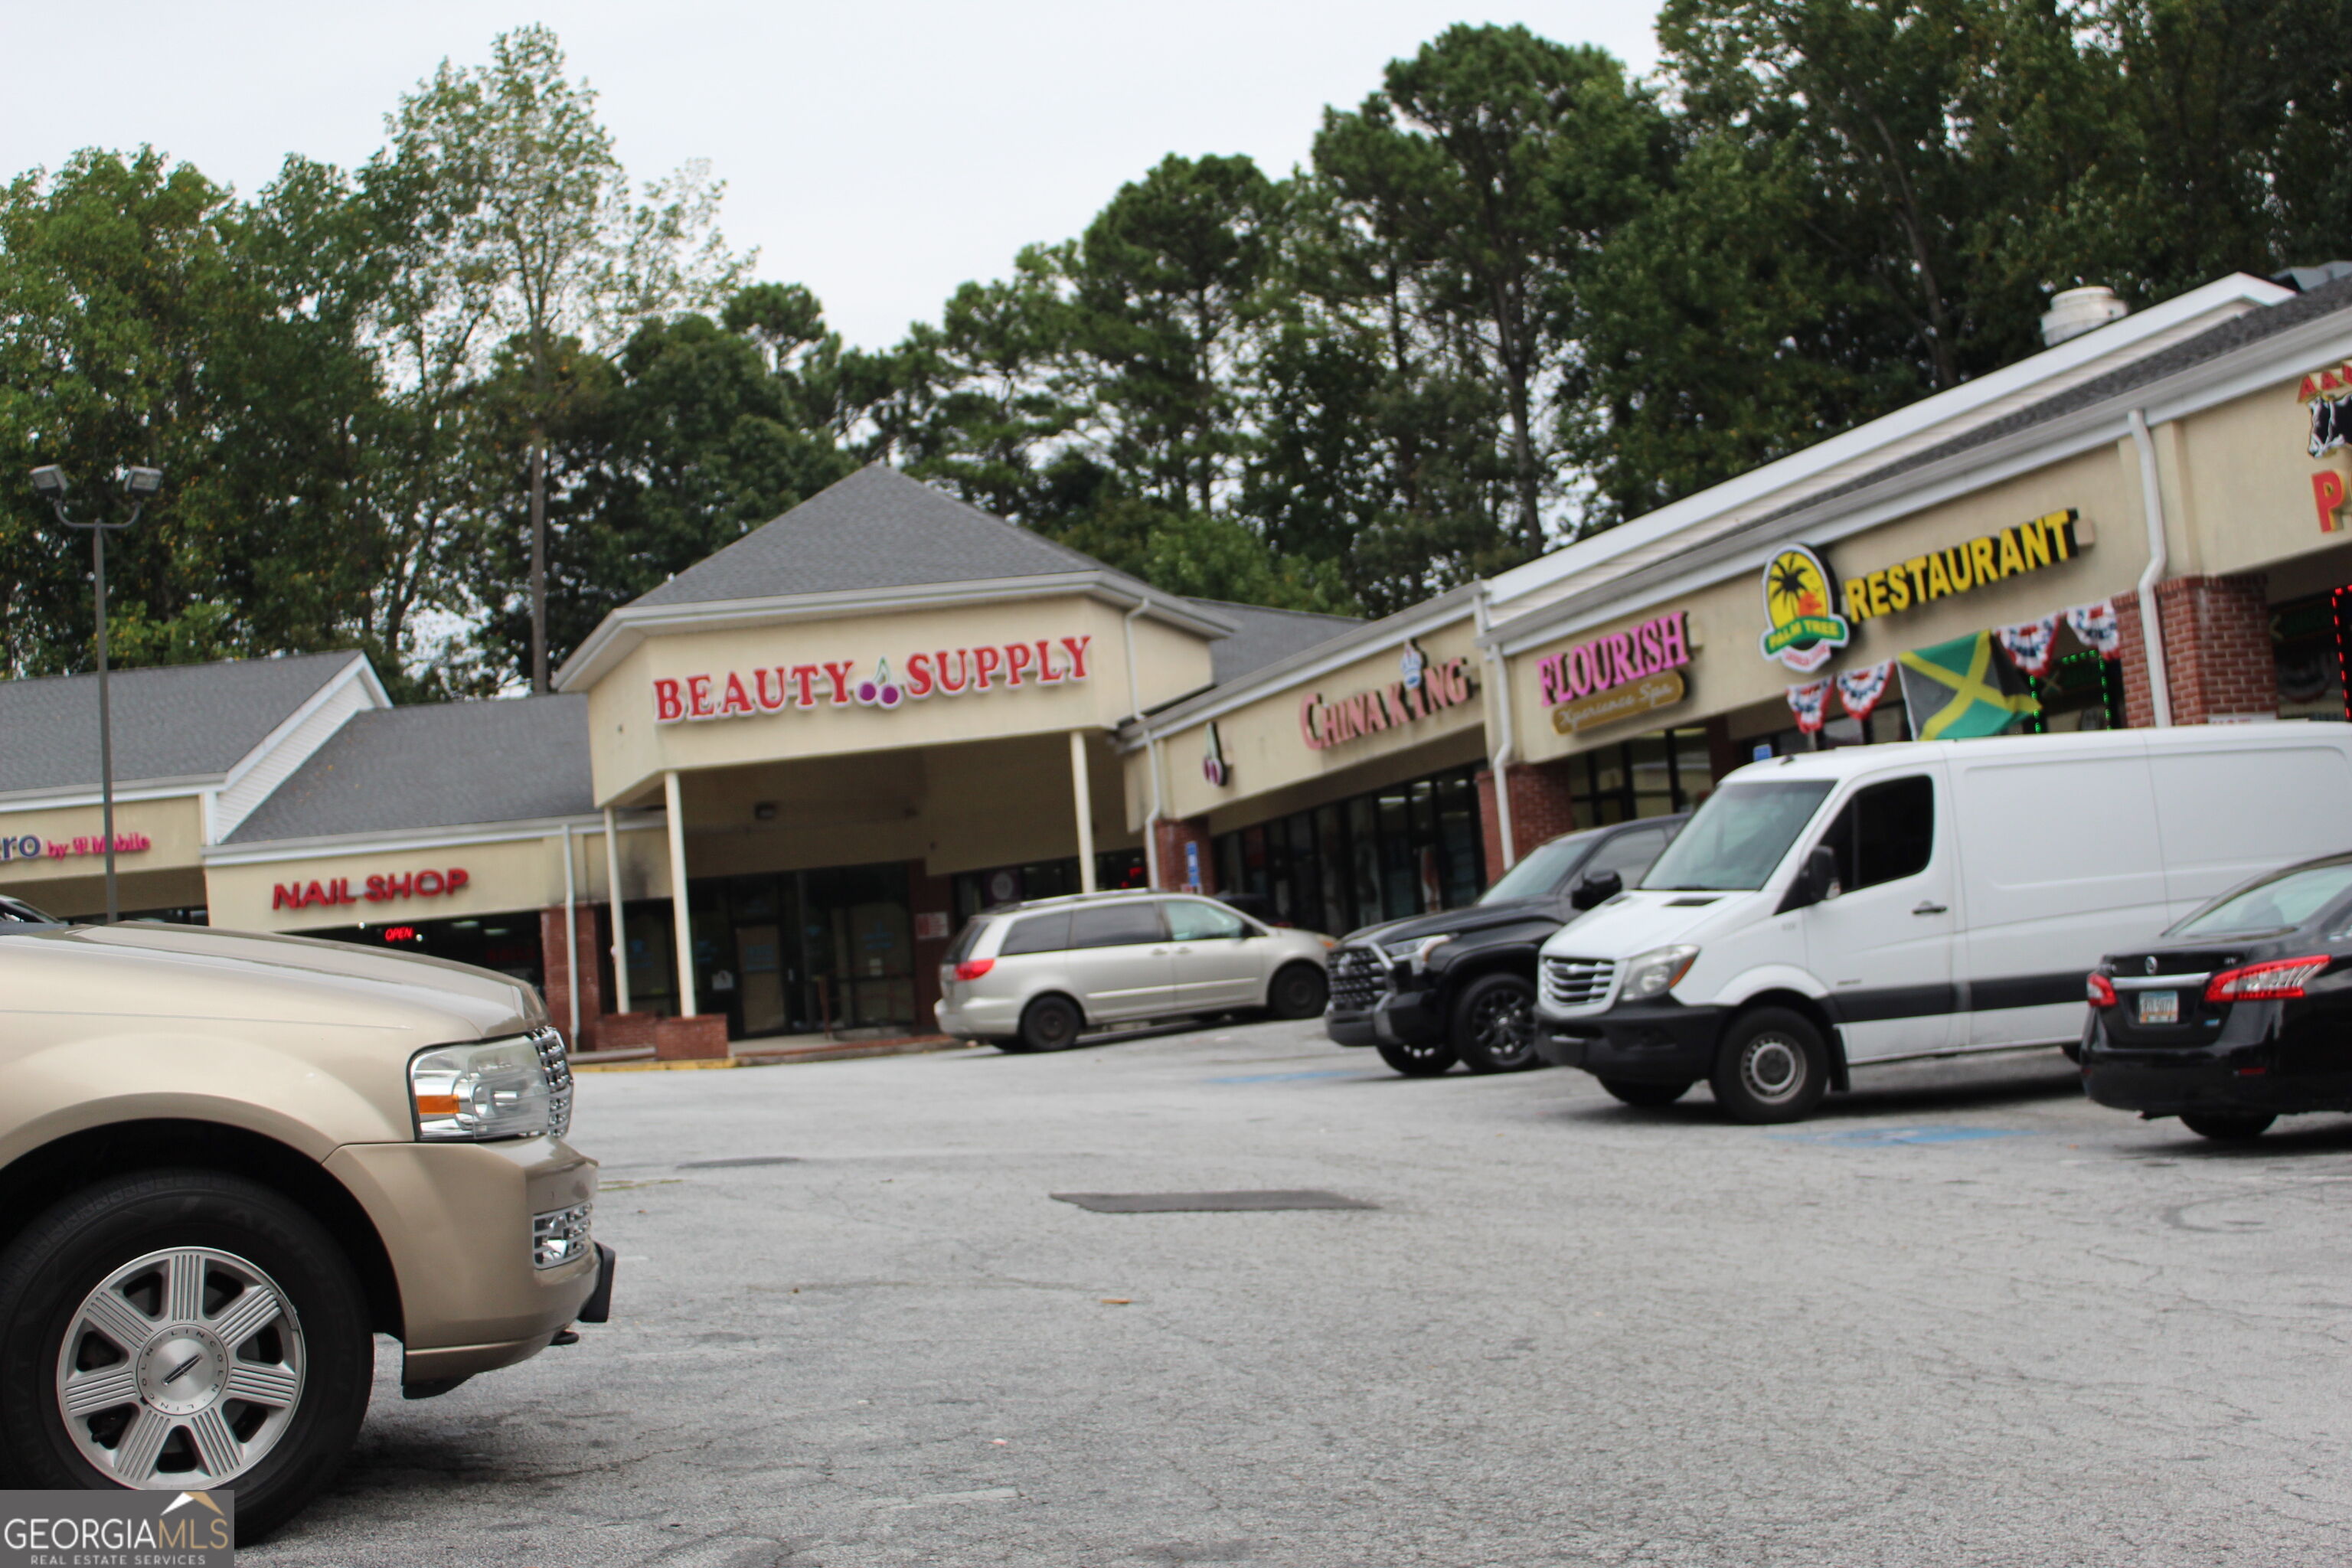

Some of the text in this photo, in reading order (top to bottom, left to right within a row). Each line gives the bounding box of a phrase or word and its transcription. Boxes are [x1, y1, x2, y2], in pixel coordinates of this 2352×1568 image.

[2311, 469, 2352, 534] P
[1844, 509, 2070, 625] RESTAURANT
[652, 635, 1093, 722] BEAUTY SUPPLY
[1536, 610, 1690, 707] FLOURISH
[1299, 656, 1468, 750] CHINA KING
[0, 834, 42, 861] ro
[47, 839, 69, 862] by
[272, 867, 469, 910] NAIL SHOP
[384, 926, 413, 942] OPEN
